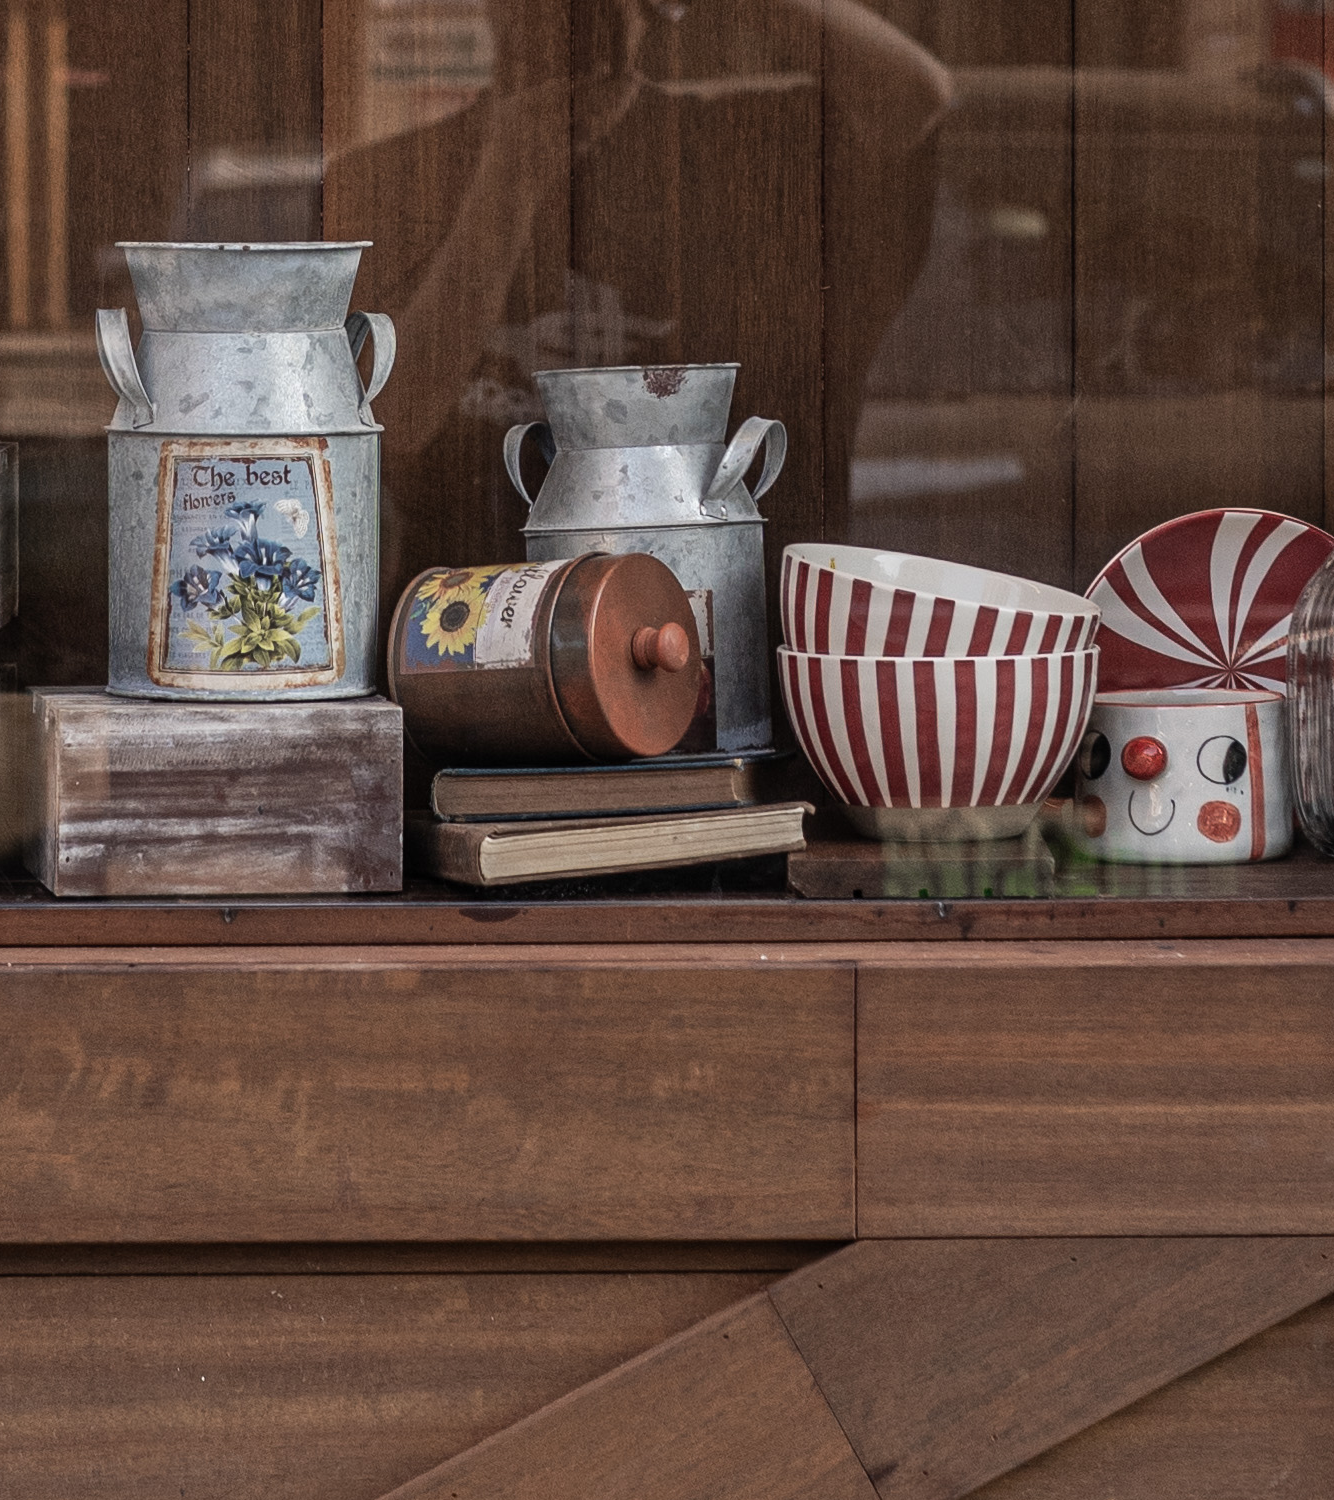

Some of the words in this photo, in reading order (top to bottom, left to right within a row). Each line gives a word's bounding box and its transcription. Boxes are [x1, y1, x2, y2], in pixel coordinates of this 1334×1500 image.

[191, 465, 236, 492] The
[245, 463, 292, 486] best
[182, 491, 237, 512] flowers
